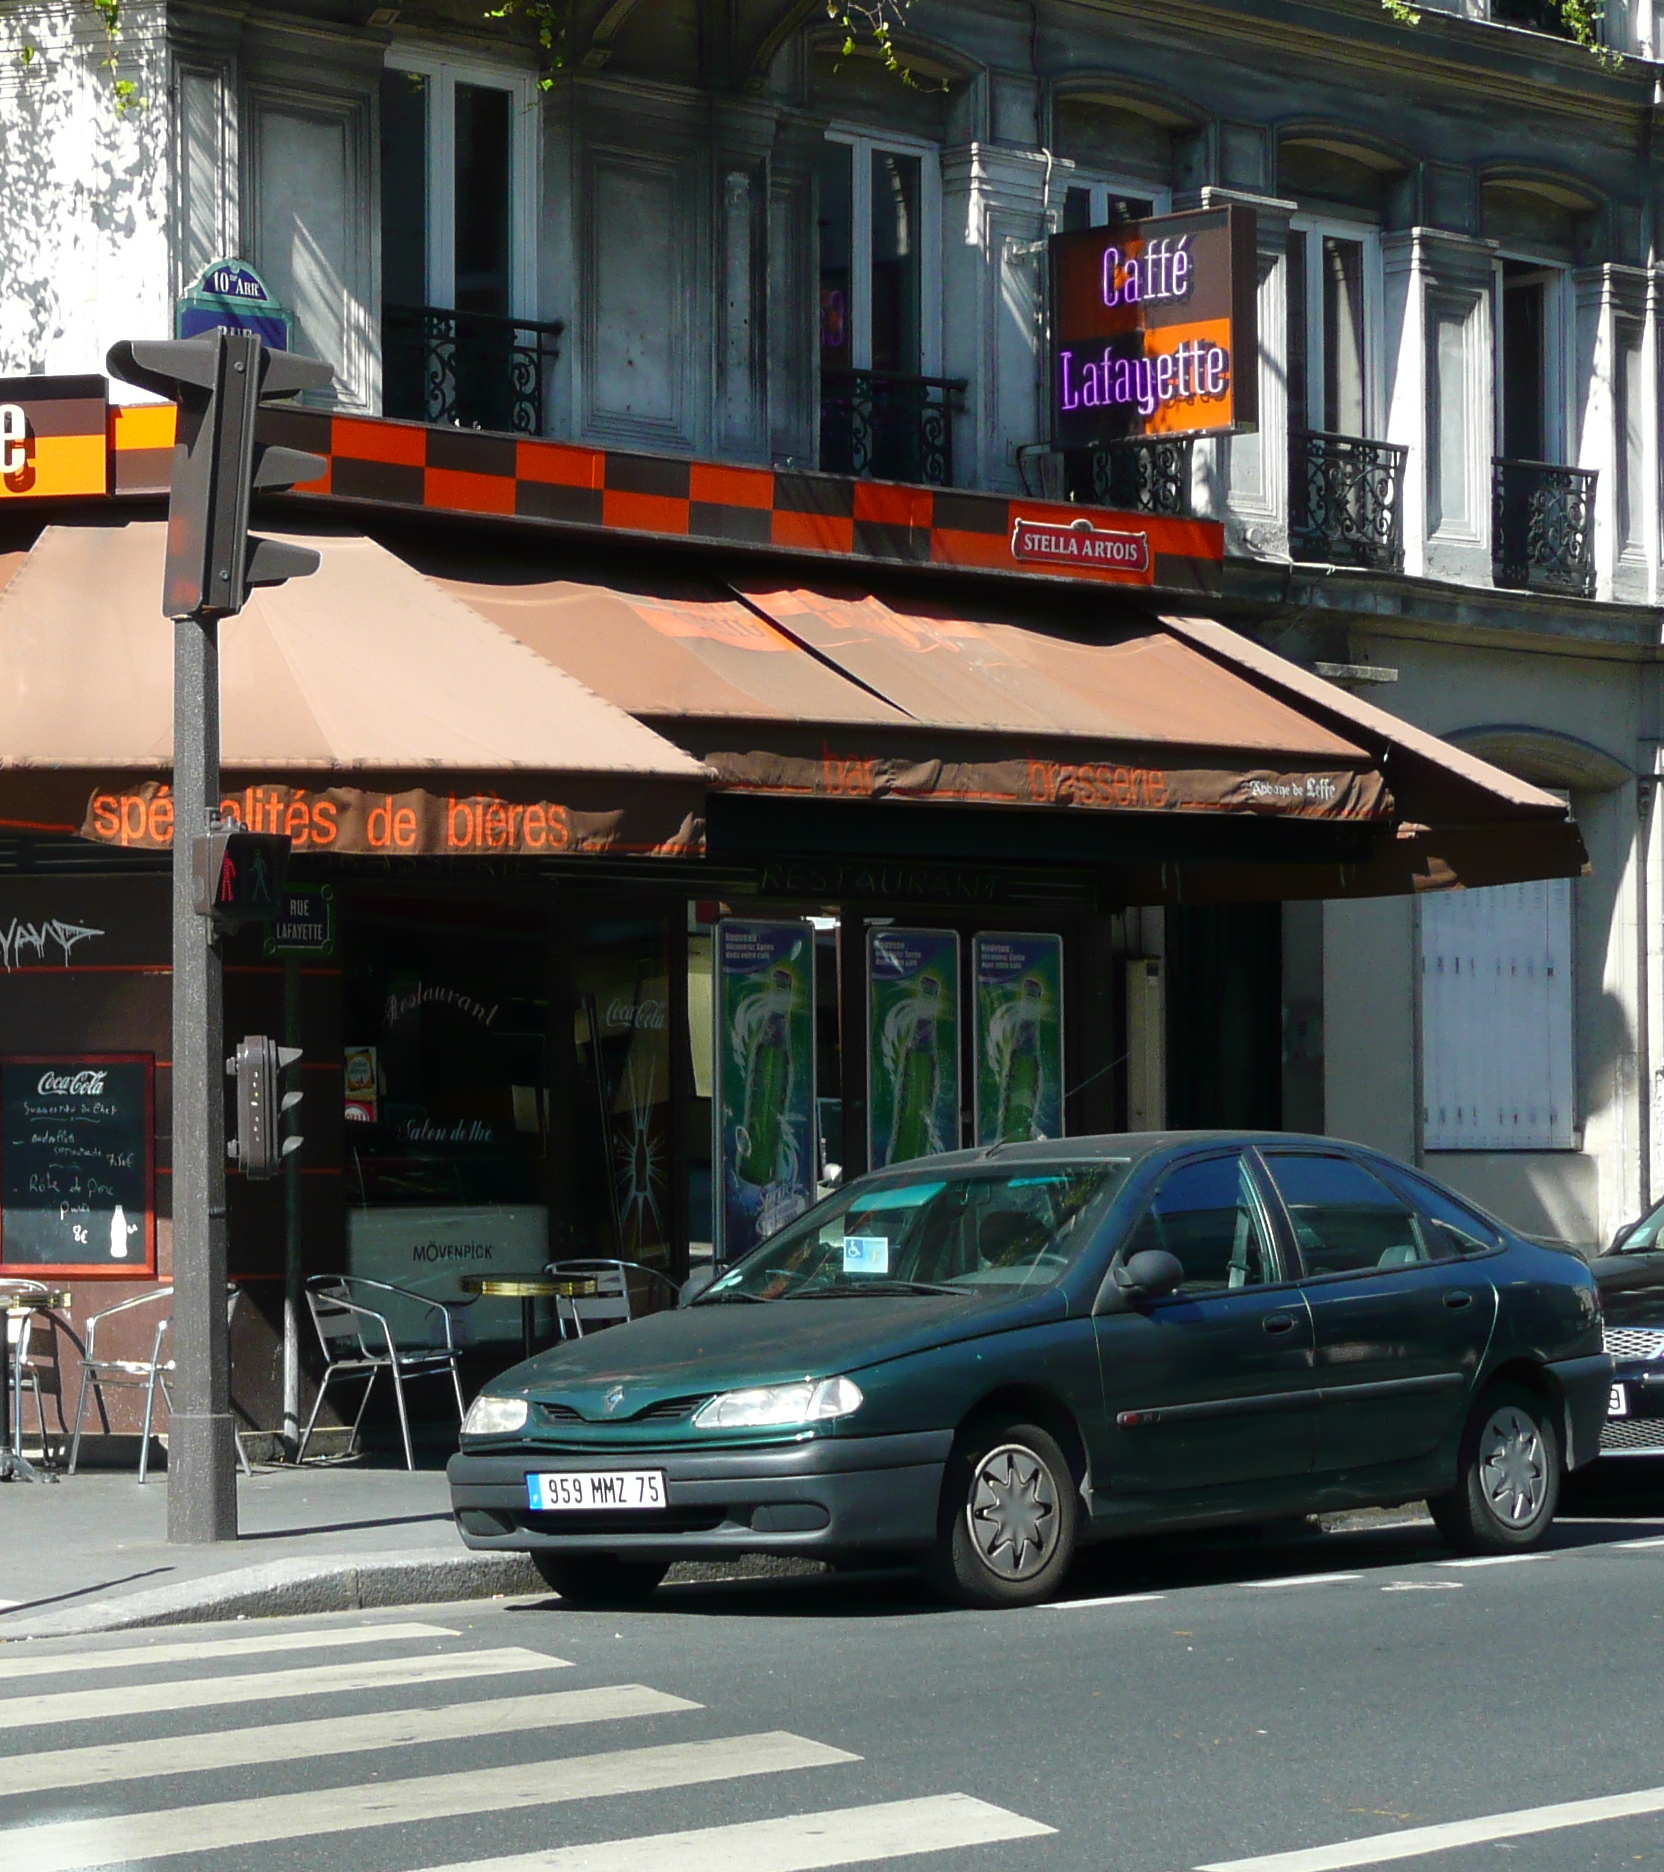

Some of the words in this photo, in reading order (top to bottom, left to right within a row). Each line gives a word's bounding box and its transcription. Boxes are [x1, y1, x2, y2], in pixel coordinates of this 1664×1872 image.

[1102, 235, 1188, 307] Caffé
[1060, 340, 1224, 415] Lafayette
[1024, 533, 1078, 556] STELLA
[1082, 540, 1138, 562] ARTOIS
[822, 739, 873, 796] bar
[1306, 777, 1335, 801] Leffe
[93, 785, 338, 847] spéalités
[367, 797, 418, 848] de
[448, 790, 570, 851] bières
[290, 899, 310, 917] RUE
[276, 922, 323, 941] LAFAYETTE
[383, 981, 499, 1028] Restaurant
[37, 1069, 108, 1095] Coca-Cola
[413, 1238, 493, 1262] MÖVENPICK
[549, 1478, 583, 1504] 959
[591, 1476, 627, 1504] MMZ
[635, 1476, 659, 1503] 75
